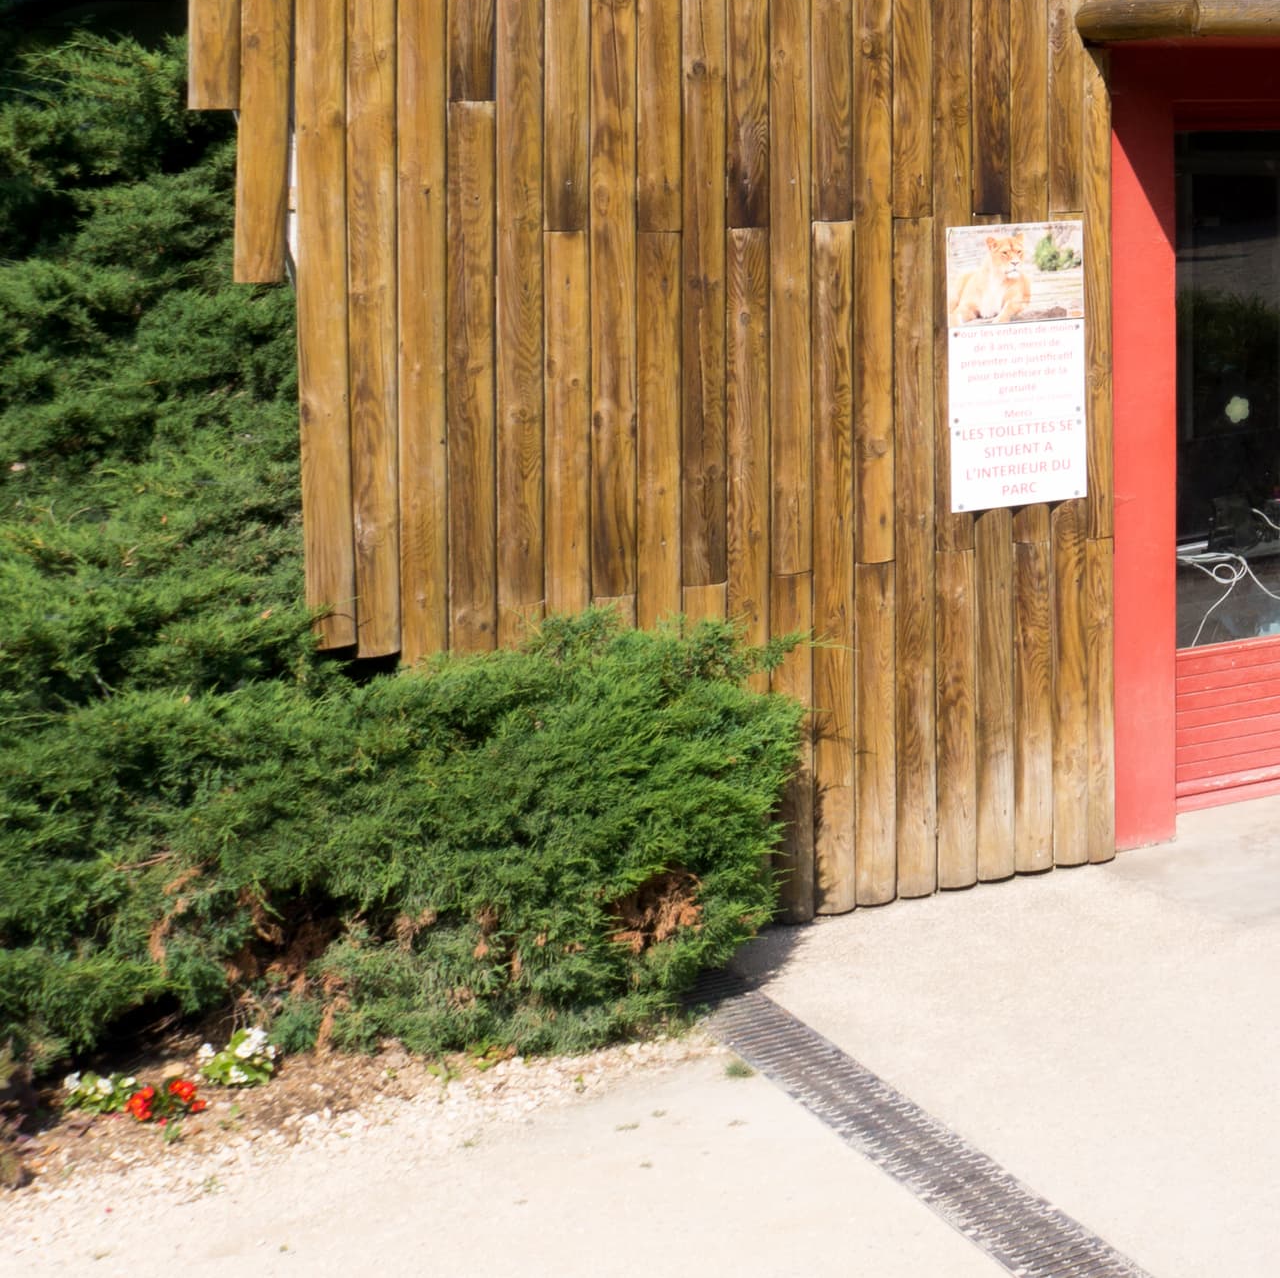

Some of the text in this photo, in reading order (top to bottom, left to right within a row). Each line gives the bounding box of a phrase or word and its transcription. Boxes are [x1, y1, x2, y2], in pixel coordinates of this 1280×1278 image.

[980, 329, 993, 337] les
[997, 326, 1033, 336] enfants
[1035, 325, 1047, 334] de
[1050, 323, 1079, 331] moin
[974, 344, 985, 352] de
[1020, 340, 1046, 350] merci
[1049, 339, 1060, 347] de
[1011, 356, 1023, 364] un
[1026, 351, 1073, 364] justificatif
[968, 372, 990, 383] pour
[1044, 367, 1056, 376] de
[1004, 409, 1033, 418] Merci
[962, 419, 1073, 441] LES TOILETTES SE
[984, 442, 1041, 458] SITUENT
[966, 458, 1071, 480] L'INTERIEUR DU
[1002, 482, 1038, 496] PARC
